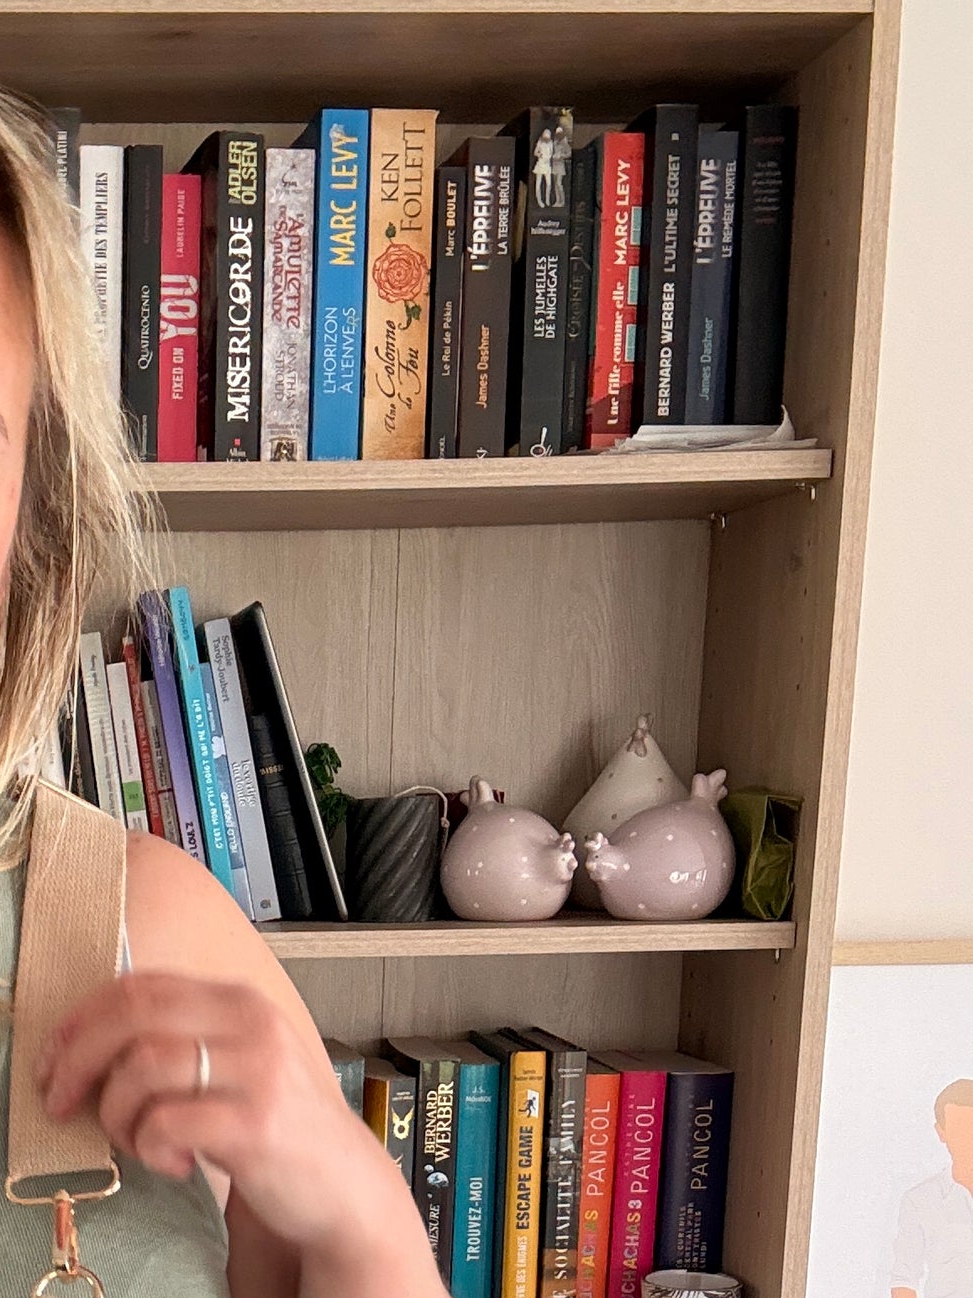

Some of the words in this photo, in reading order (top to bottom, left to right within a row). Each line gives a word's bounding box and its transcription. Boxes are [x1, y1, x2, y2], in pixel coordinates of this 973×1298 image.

[241, 141, 257, 205] OLSEN
[329, 130, 359, 190] LEVY
[380, 152, 399, 203] KEN
[400, 121, 426, 232] FOLLETT
[615, 159, 631, 205] LEVY
[666, 154, 681, 205] SECRET
[724, 160, 737, 200] MORTEL
[95, 172, 108, 236] TEMPLIERS
[446, 181, 457, 227] BOULET
[496, 166, 511, 205] BRÛLÉE
[329, 199, 357, 266] MARC
[467, 164, 495, 271] L'ÉPREUVE
[498, 206, 509, 238] TERRE
[692, 159, 721, 264] L'ÉPREUVE
[721, 203, 736, 243] REMÈDE
[95, 239, 108, 258] DES
[444, 229, 456, 257] Marc
[497, 240, 508, 255] LA
[613, 211, 628, 265] MARC
[664, 208, 679, 272] L'ULTIME
[721, 244, 733, 258] LE
[159, 273, 198, 341] YOU
[534, 256, 547, 317] JUMELLES
[546, 255, 559, 319] HIGHGATE
[612, 281, 626, 309] elle
[441, 301, 453, 329] Pékin
[442, 331, 452, 344] de
[533, 318, 545, 338] LES
[545, 321, 556, 339] DE
[611, 312, 624, 363] comme
[660, 282, 675, 344] WERBER
[172, 347, 183, 364] ON
[323, 307, 338, 394] L'HORIZON
[374, 320, 396, 398] Colonne
[477, 324, 491, 370] Dashner
[700, 317, 714, 364] Dashner
[172, 366, 184, 400] FIXED
[339, 377, 354, 393] À
[398, 347, 421, 394] Feu
[441, 365, 451, 376] Le
[475, 374, 488, 409] James
[657, 347, 673, 416] BERNARD
[699, 365, 713, 400] James
[384, 403, 396, 433] Une
[220, 633, 234, 667] Sophie
[424, 1090, 438, 1154] BERNARD
[436, 1081, 455, 1163] WERBER
[630, 1097, 656, 1194] PANCOL
[689, 1099, 714, 1190] PANCOL
[517, 1125, 534, 1169] GAME
[586, 1100, 611, 1196] PANCOL
[465, 1176, 484, 1261] TROUVEZ-MOI
[515, 1173, 532, 1230] ESCAPE
[553, 1176, 572, 1280] SOCIALITE
